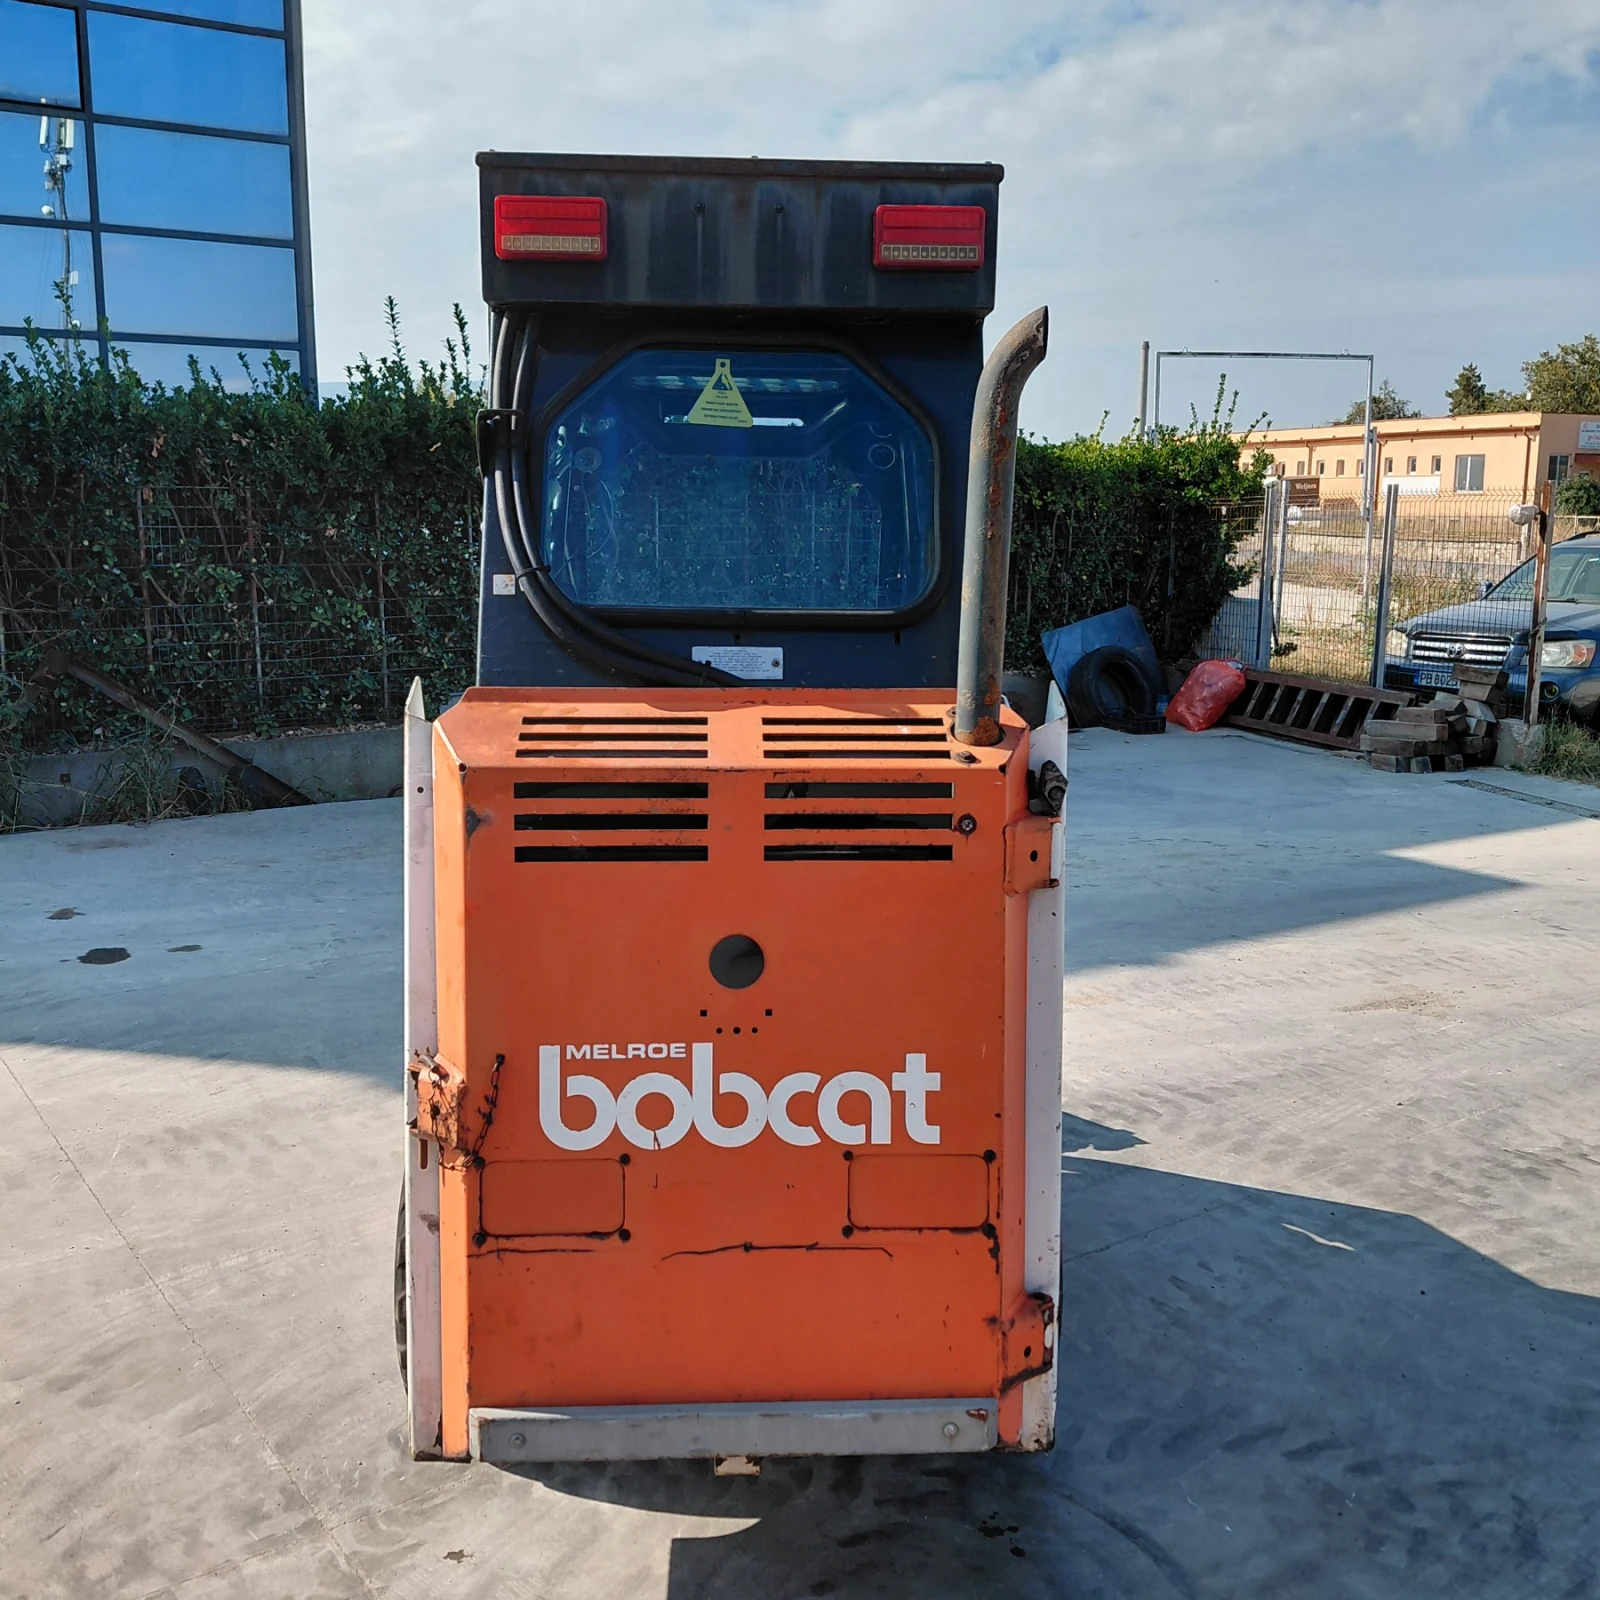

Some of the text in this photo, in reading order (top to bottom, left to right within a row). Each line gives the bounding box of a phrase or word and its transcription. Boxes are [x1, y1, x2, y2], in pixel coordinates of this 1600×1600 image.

[1420, 672, 1432, 684] PB
[565, 1043, 687, 1060] MELROE
[539, 1042, 941, 1151] bobcat
